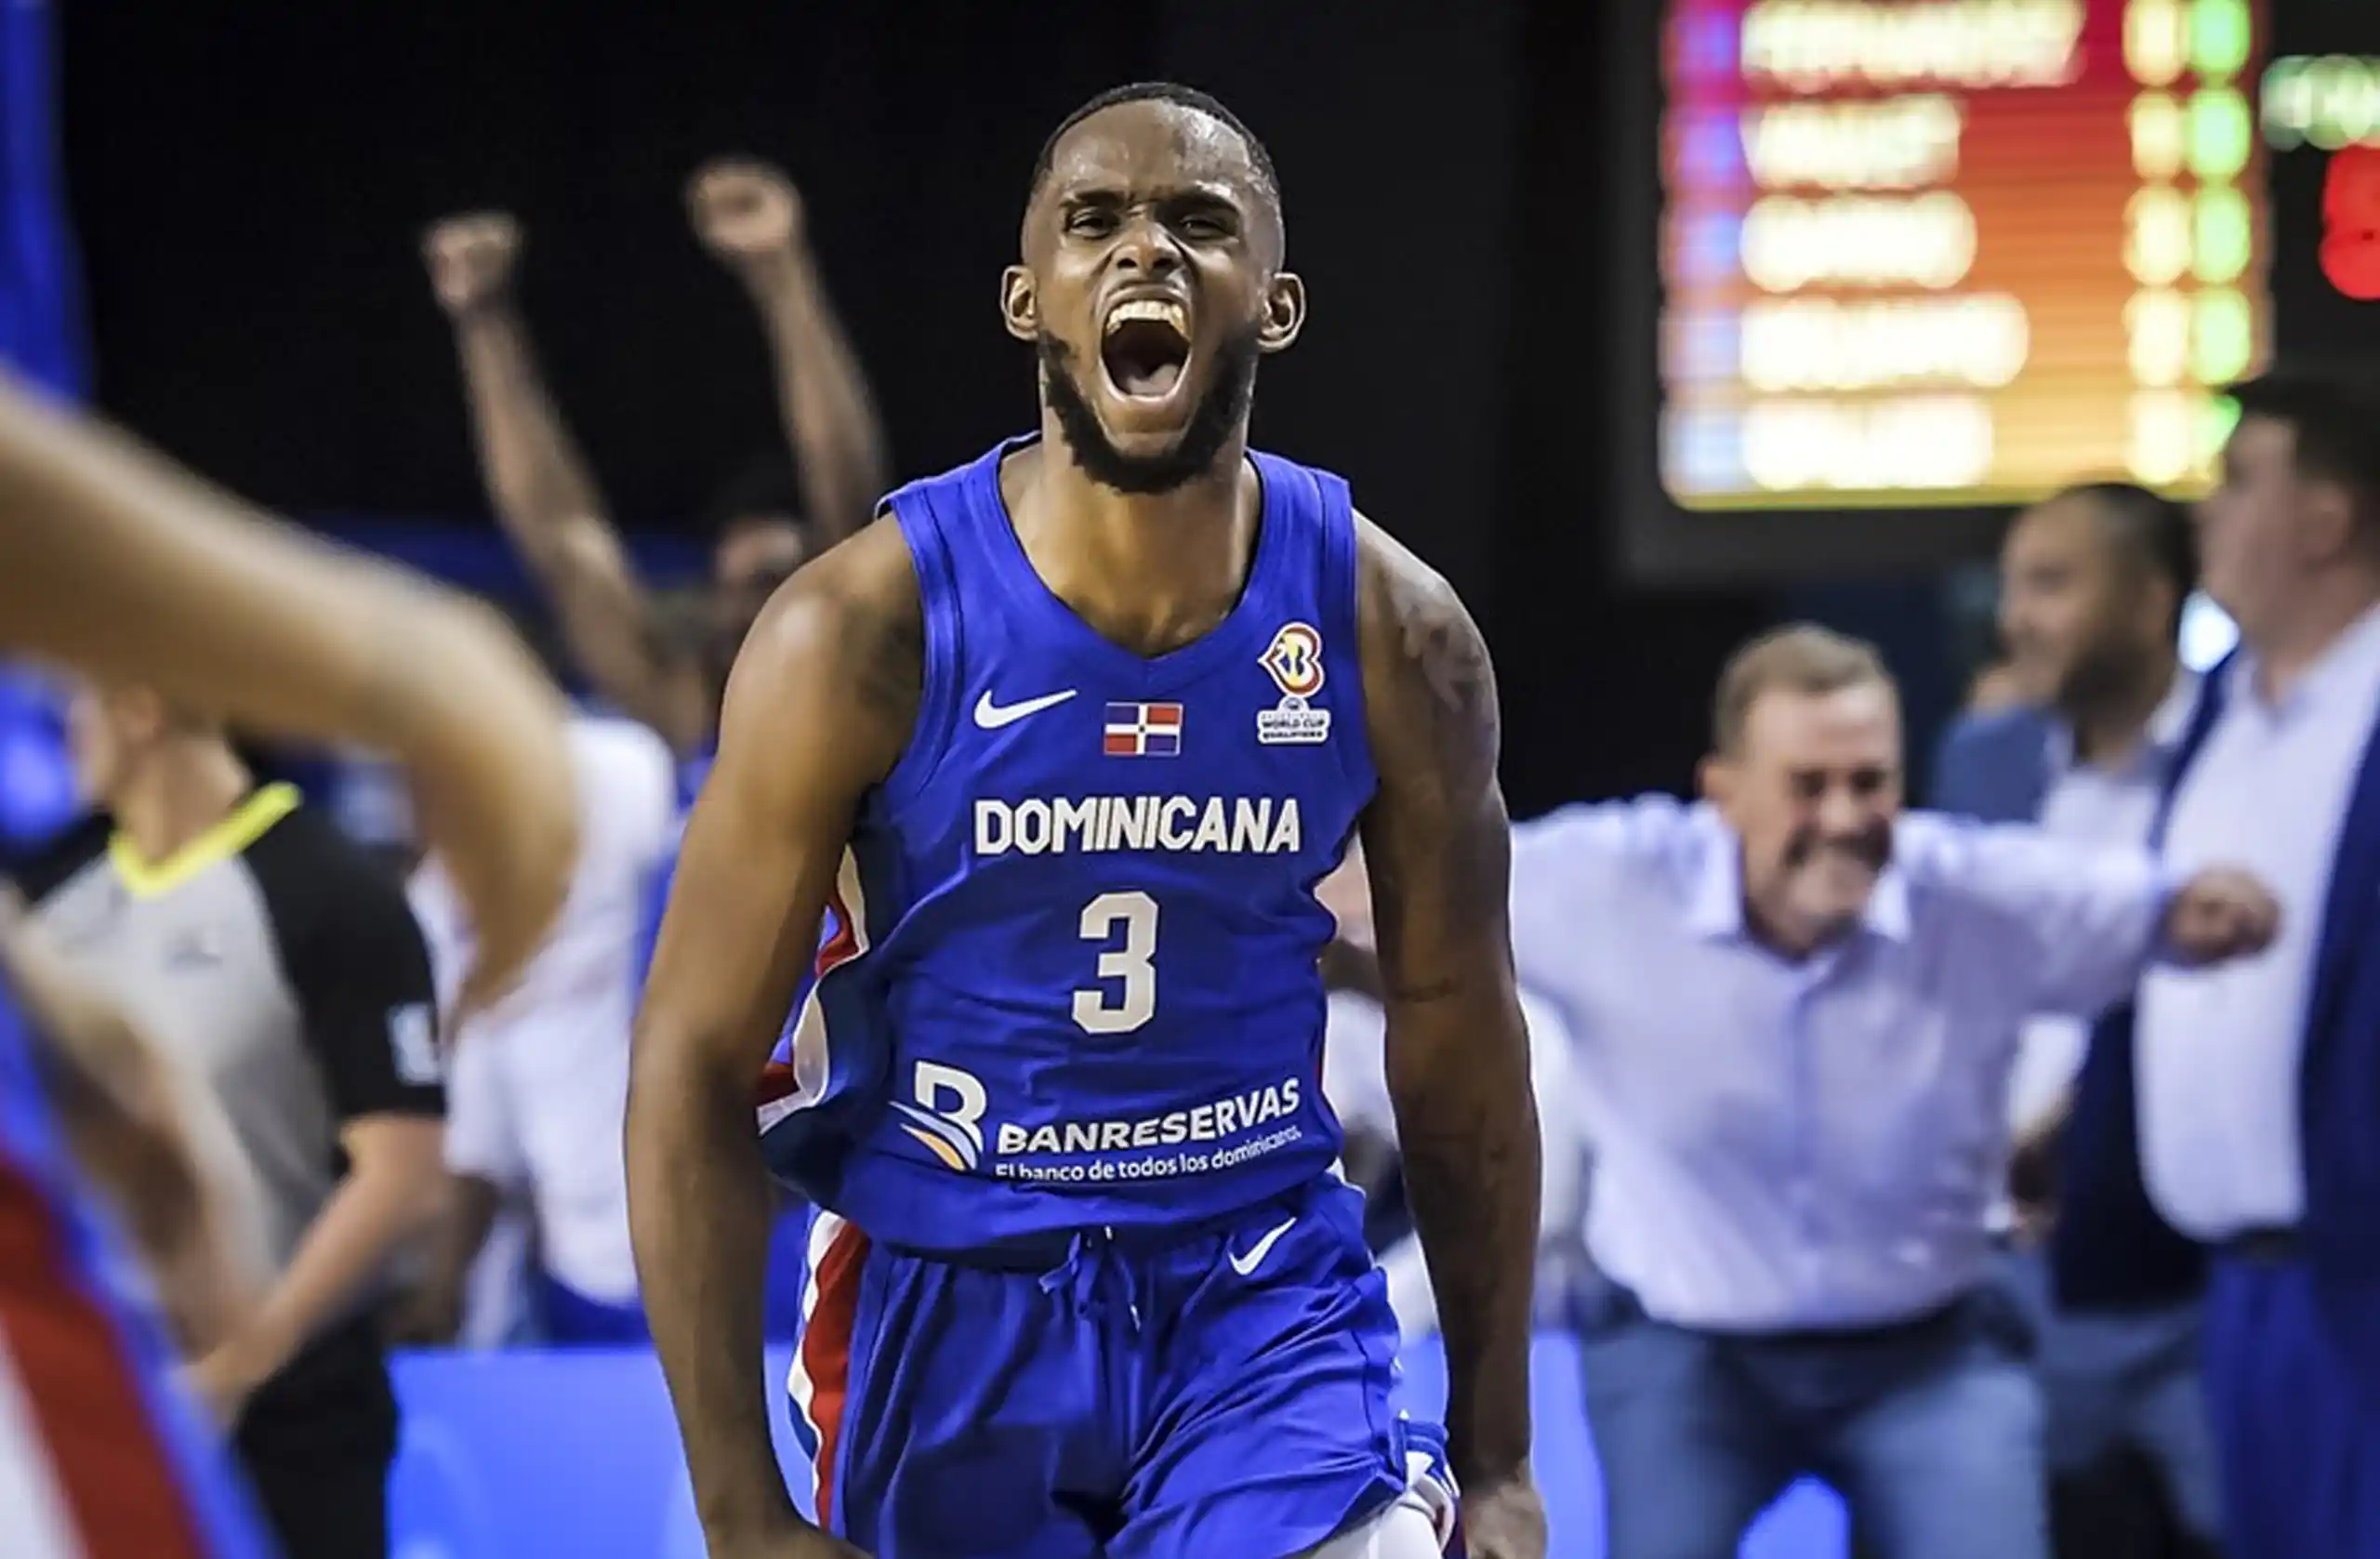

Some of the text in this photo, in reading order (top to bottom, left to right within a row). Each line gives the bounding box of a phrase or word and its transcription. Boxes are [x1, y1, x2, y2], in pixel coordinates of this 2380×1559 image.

[975, 796, 1301, 854] DOMINICANA
[1072, 891, 1159, 1034] 3
[997, 1077, 1300, 1154] BANRESERVAS
[995, 1162, 1015, 1177] El
[1018, 1162, 1085, 1181] banco
[1088, 1159, 1116, 1180] de
[1117, 1155, 1178, 1179] todos
[1179, 1152, 1210, 1173] los
